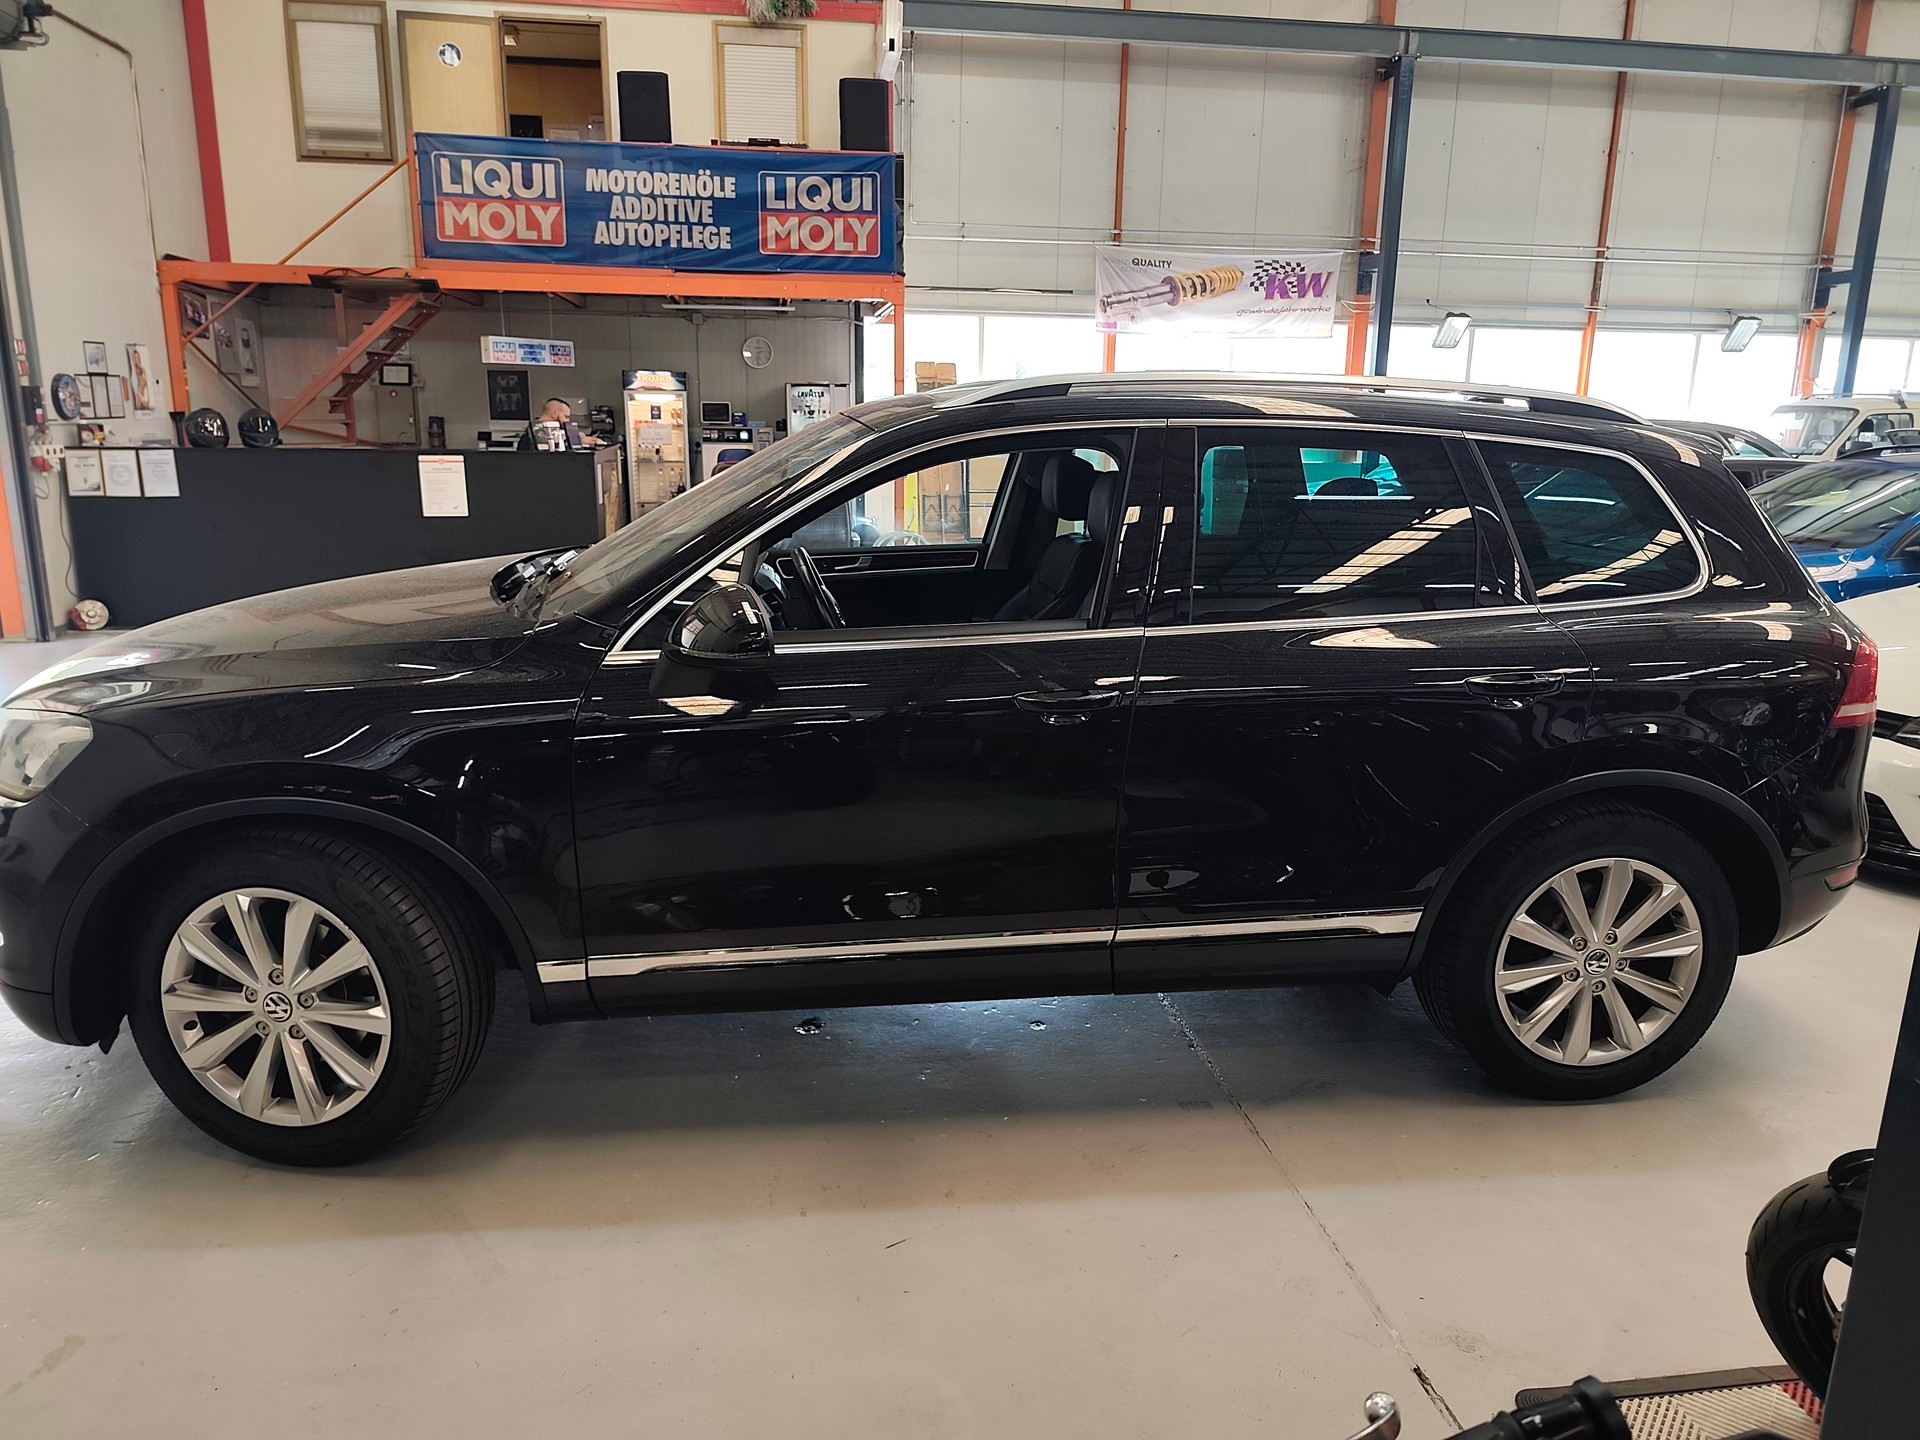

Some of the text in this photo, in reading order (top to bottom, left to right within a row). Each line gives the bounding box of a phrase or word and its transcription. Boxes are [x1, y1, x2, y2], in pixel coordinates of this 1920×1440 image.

[440, 157, 557, 200] LIQUI
[585, 168, 737, 199] MOTORENÖLE
[765, 175, 873, 213] LIQUI
[443, 200, 561, 241] MOLY
[609, 195, 714, 224] ADDITIVE
[594, 220, 732, 250] AUTOPFLEGE
[766, 215, 877, 252] MOLY
[1131, 257, 1173, 270] QUALITY
[1263, 271, 1335, 301] KW
